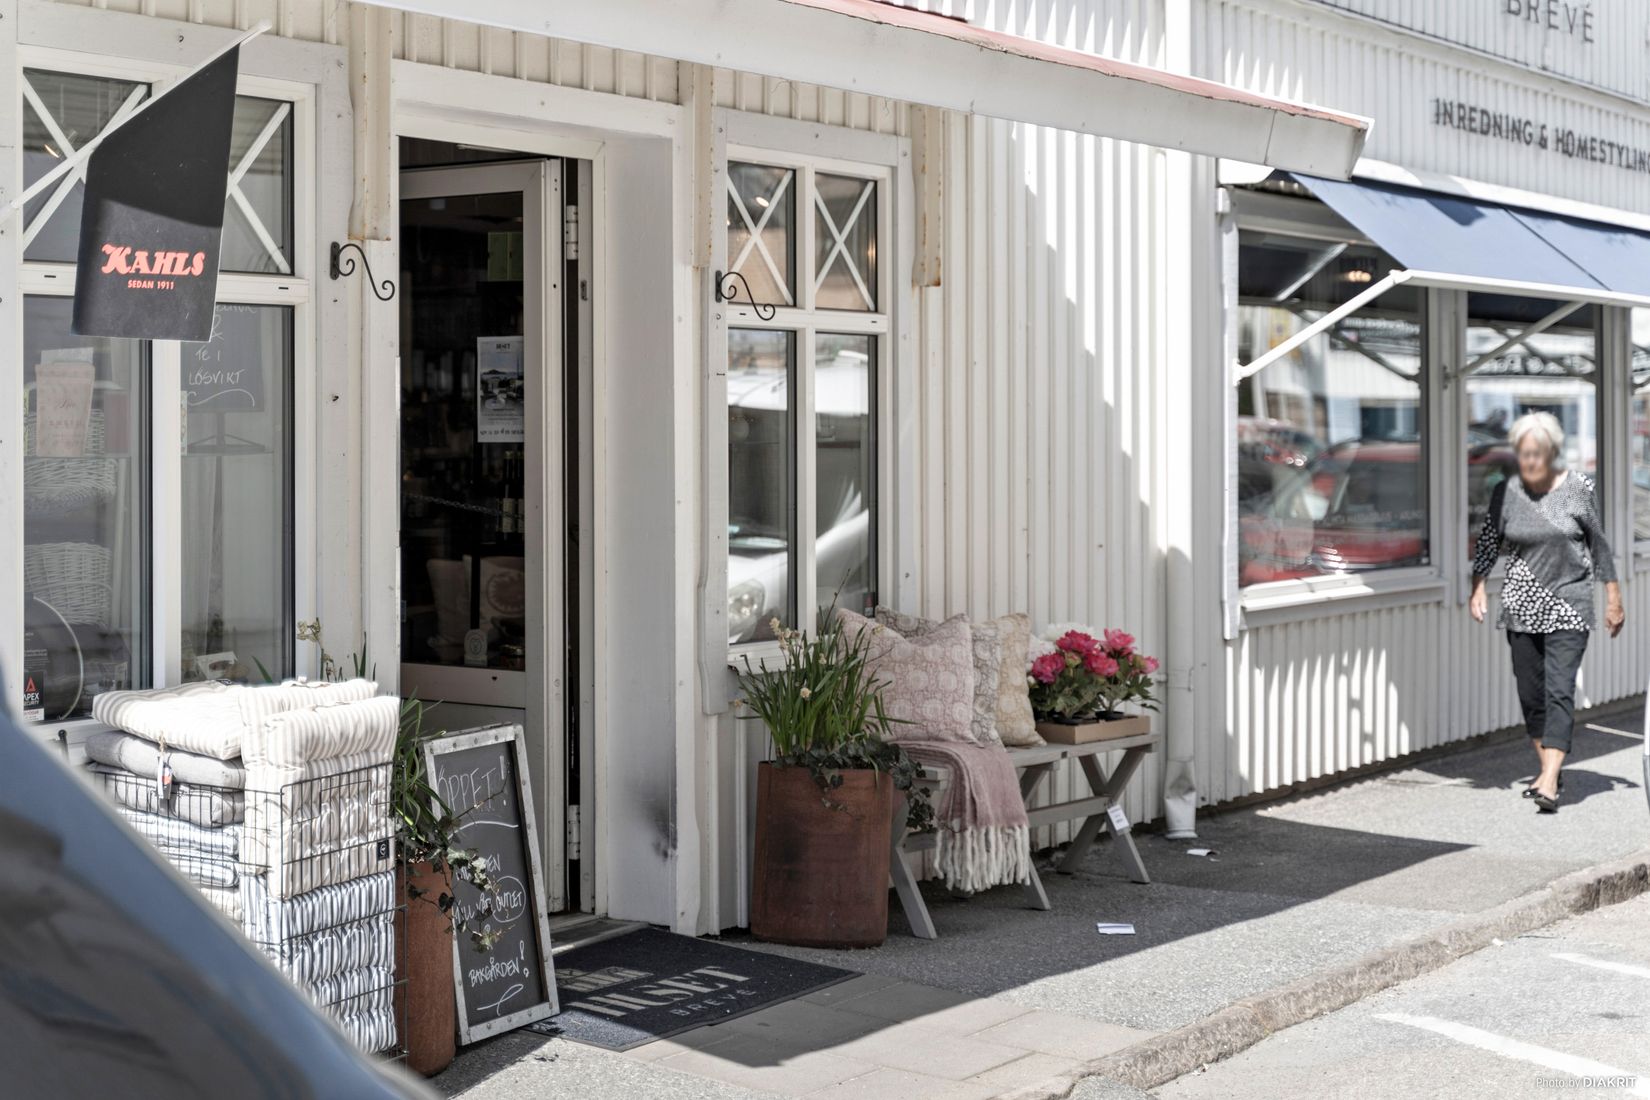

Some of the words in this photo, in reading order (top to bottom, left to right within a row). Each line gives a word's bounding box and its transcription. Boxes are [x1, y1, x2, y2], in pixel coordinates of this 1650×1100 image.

[1433, 98, 1534, 146] INREDNING
[1538, 124, 1549, 150] &
[101, 244, 205, 276] KAHLS
[127, 280, 154, 289] SEDAN
[157, 281, 174, 290] 1911
[195, 345, 211, 361] TE
[189, 366, 246, 385] LÖSVIKT
